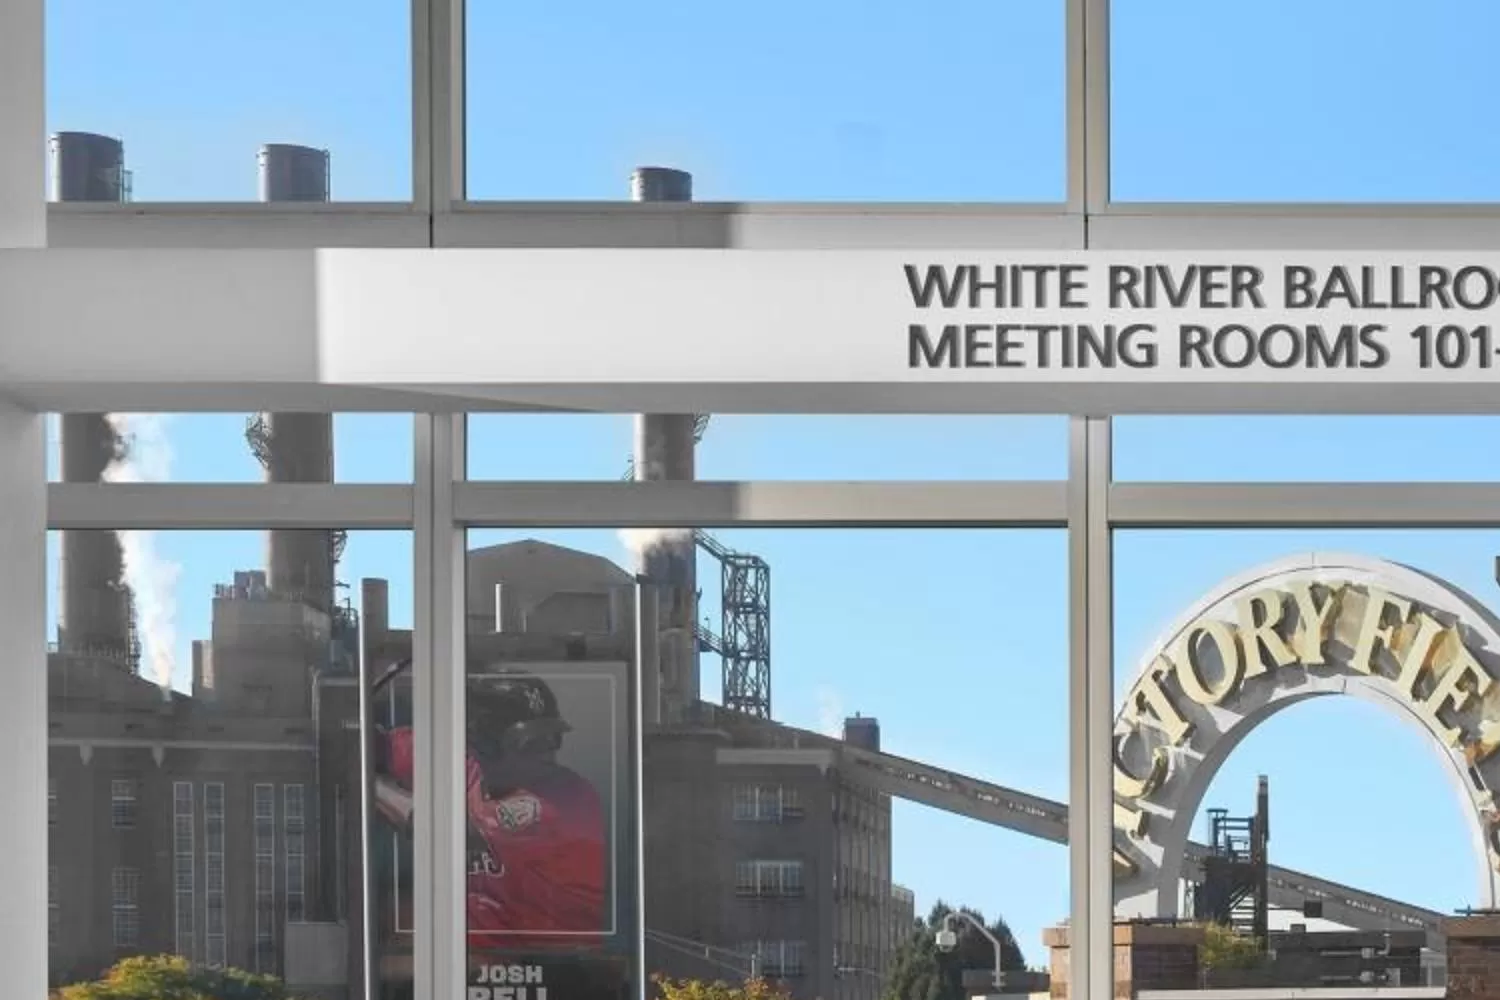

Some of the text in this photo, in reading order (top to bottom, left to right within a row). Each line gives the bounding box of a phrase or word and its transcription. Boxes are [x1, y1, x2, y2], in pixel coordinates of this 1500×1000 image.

[903, 264, 1089, 309] WHITE
[1108, 264, 1267, 309] RIVER
[908, 323, 1159, 369] MEETING
[1178, 323, 1391, 369] ROOMS
[1114, 581, 1339, 872] CTORY
[477, 965, 543, 984] JOSH
